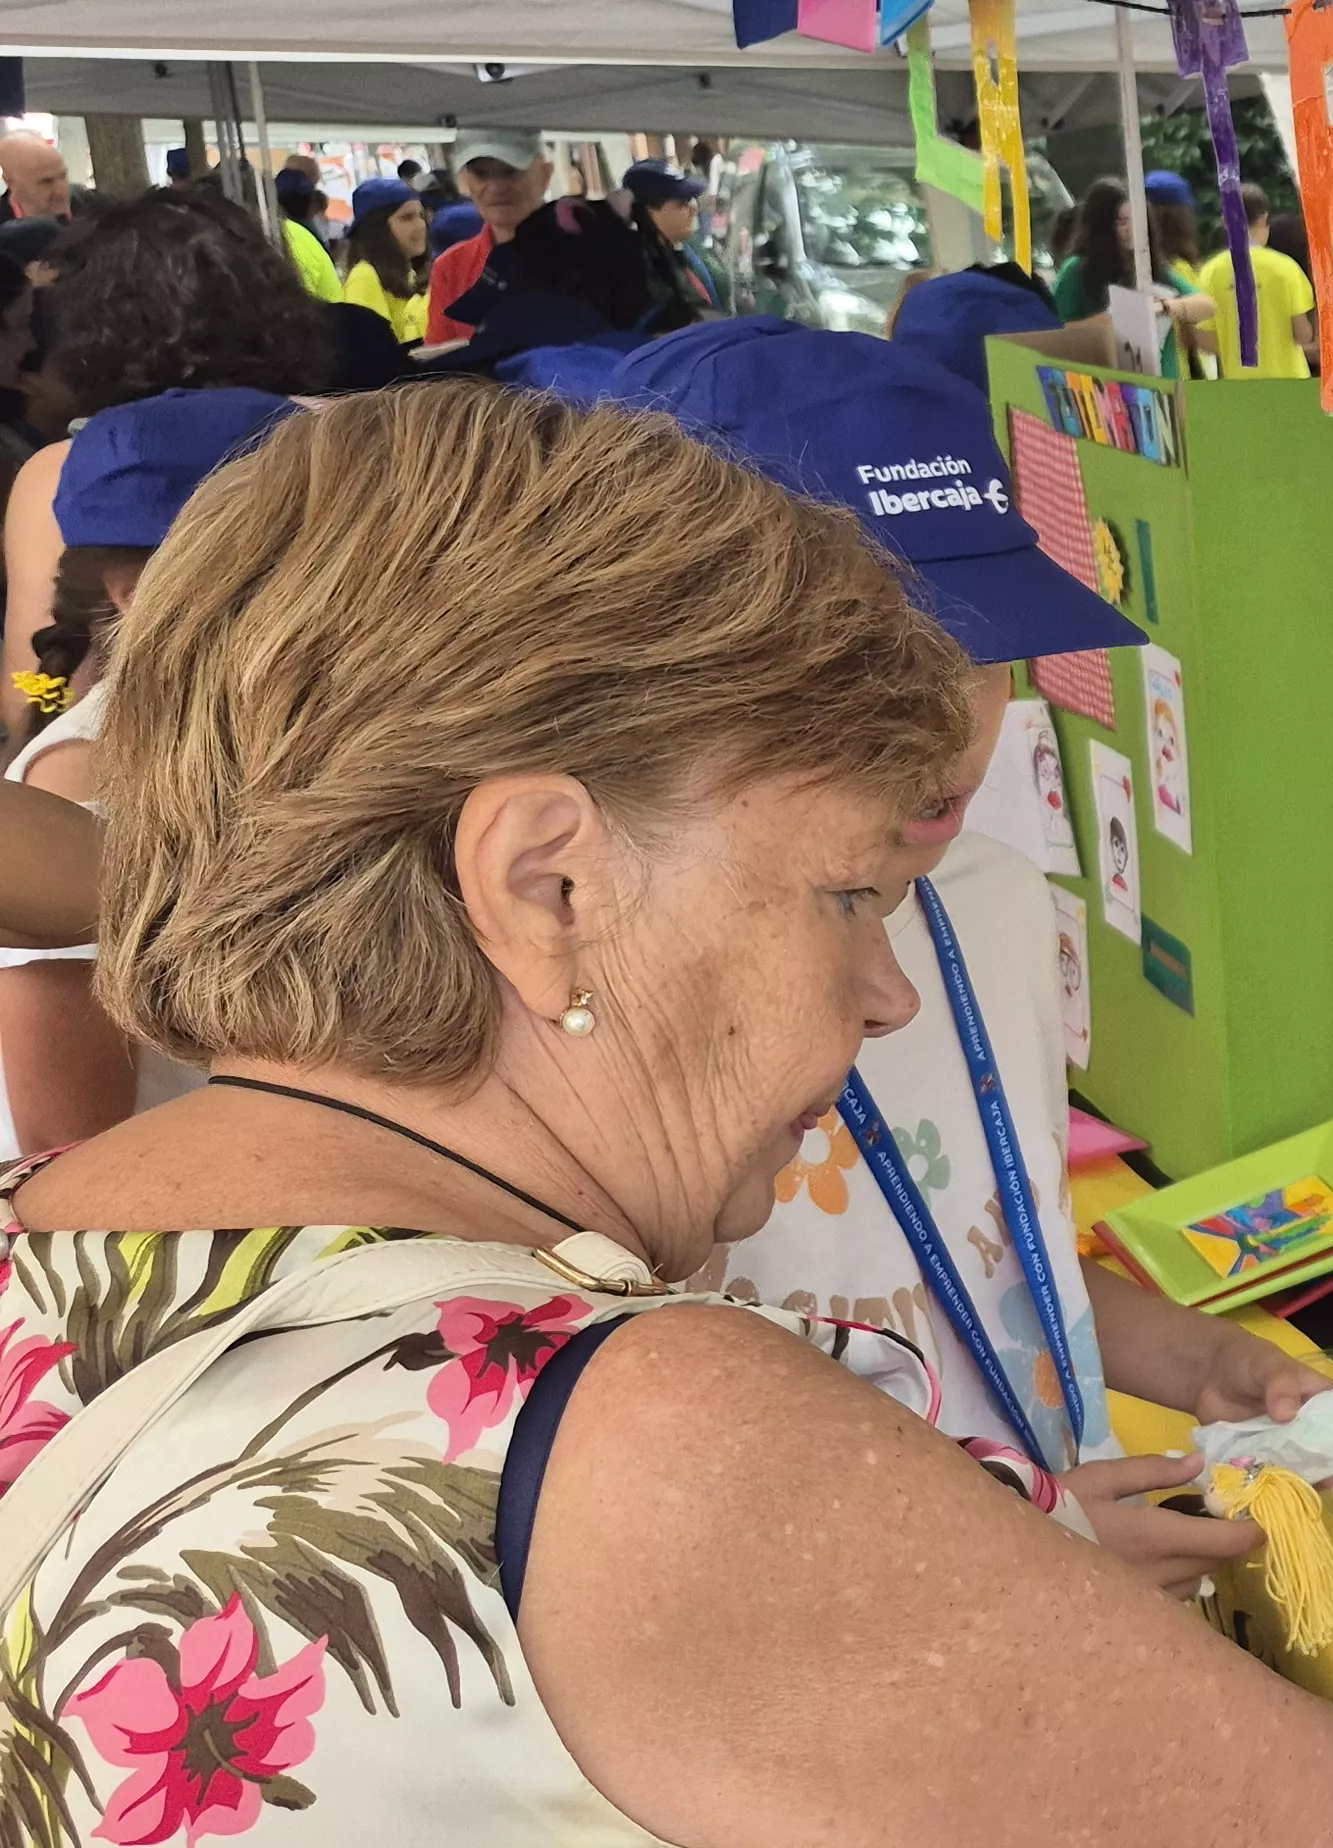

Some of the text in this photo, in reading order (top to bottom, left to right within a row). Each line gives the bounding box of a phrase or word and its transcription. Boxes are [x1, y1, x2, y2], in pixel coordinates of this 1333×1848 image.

[856, 455, 972, 485] Fundación
[868, 479, 984, 517] Ibercaja
[951, 963, 987, 1062] APRENDIENDO
[990, 1100, 1015, 1168] IBERCAJA
[1007, 1169, 1037, 1251] FUNDACIÓN
[877, 1151, 928, 1242] APRENDIENDO
[923, 1243, 933, 1256] A
[929, 1253, 973, 1330] EMPRENDER
[971, 1330, 987, 1359] CON
[1031, 1252, 1047, 1283] CON
